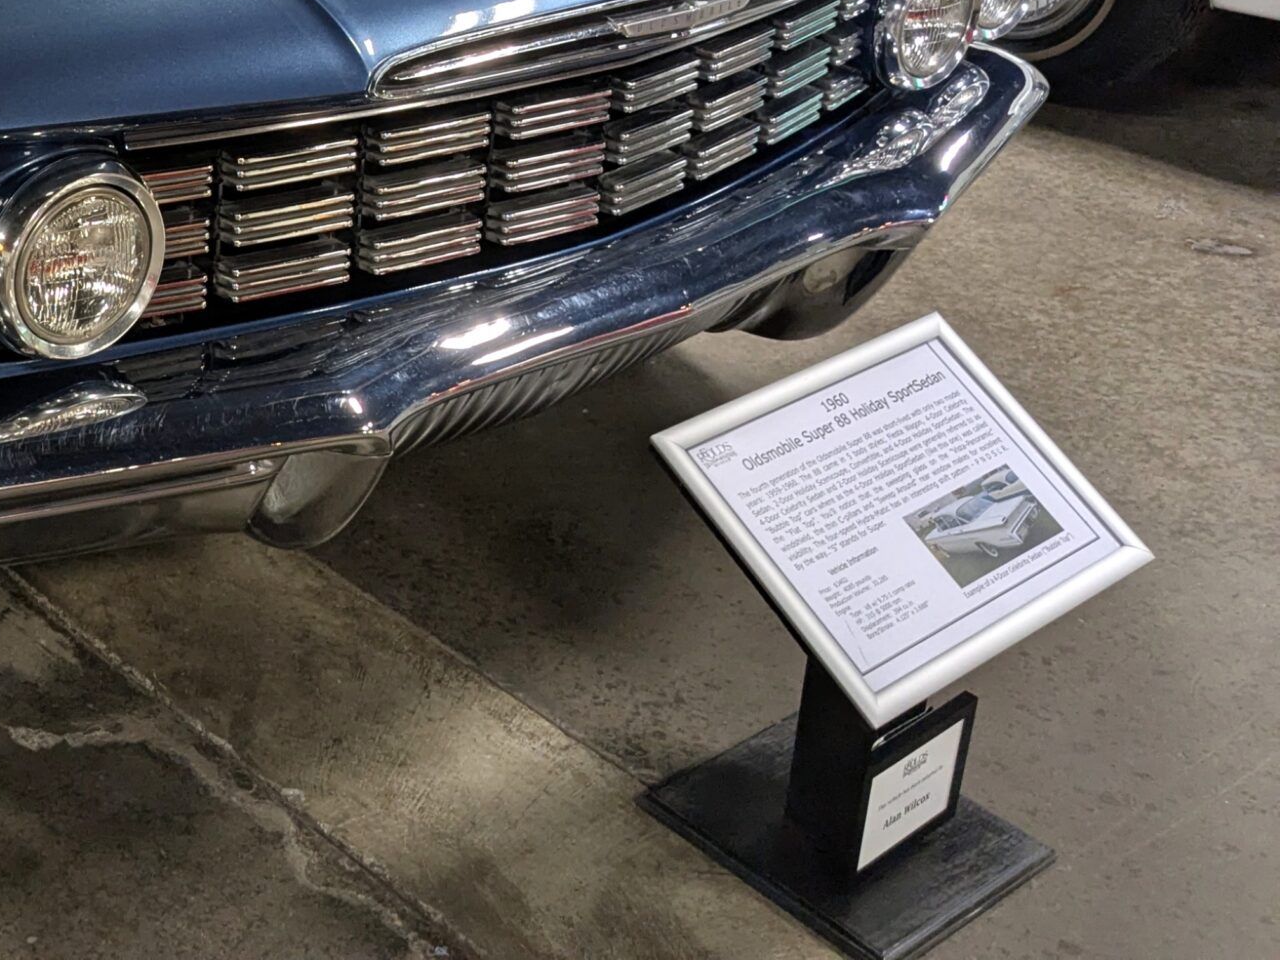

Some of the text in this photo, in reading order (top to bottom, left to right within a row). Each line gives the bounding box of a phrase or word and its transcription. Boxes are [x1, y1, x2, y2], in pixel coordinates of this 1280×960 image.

[820, 392, 850, 413] 1960
[742, 437, 804, 471] Oldsmobile
[801, 422, 835, 443] Super
[833, 413, 851, 428] 88
[848, 397, 890, 421] Holiday
[887, 371, 946, 403] SportSedan
[793, 483, 817, 497] Holiday
[911, 427, 933, 439] Holiday
[816, 444, 848, 462] Oldsmobile
[846, 436, 864, 448] Super
[827, 546, 879, 575] Vehicle Information
[883, 792, 931, 830] Alan Wilcox
